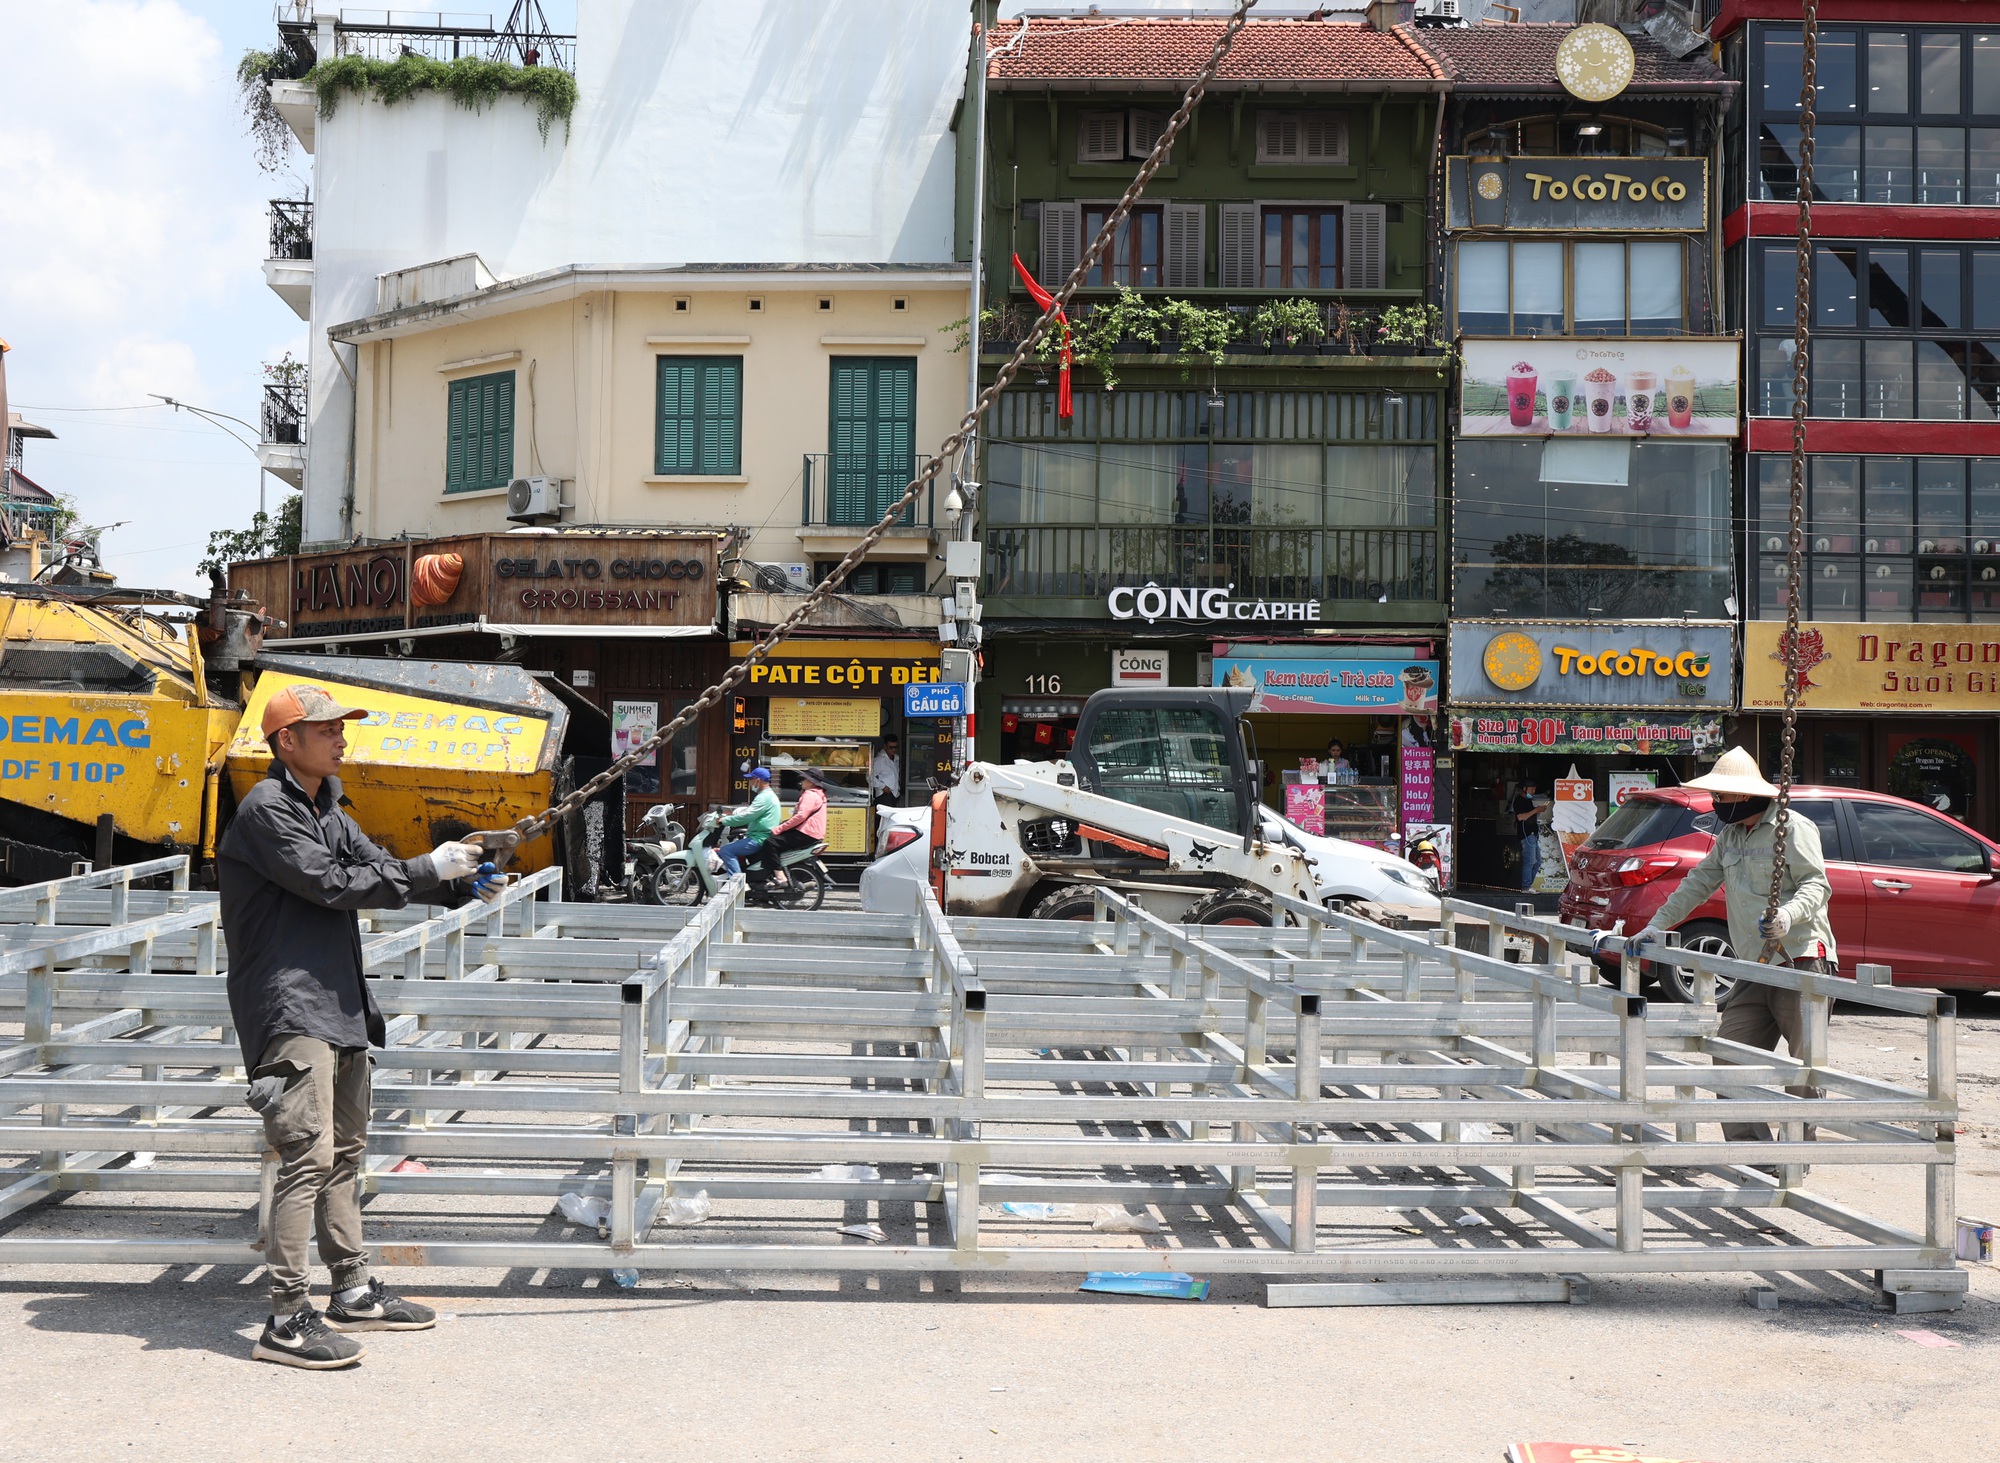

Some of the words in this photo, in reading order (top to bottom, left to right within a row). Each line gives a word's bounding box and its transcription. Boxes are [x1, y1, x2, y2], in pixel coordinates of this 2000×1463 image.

[496, 558, 601, 579] GELATO
[610, 558, 705, 580] CHOCO
[520, 588, 680, 611] CROISSANT
[1108, 581, 1230, 625] CỘNG
[1858, 633, 2000, 669] Dragon
[1119, 657, 1162, 672] CỘNG
[751, 665, 820, 684] PATE
[826, 658, 883, 690] CỘT
[1265, 669, 1297, 687] Kem
[1298, 669, 1330, 687] tươi
[1340, 667, 1365, 687] Trà
[1366, 668, 1394, 687] sữa
[1883, 670, 1954, 693] Suoi
[931, 685, 950, 695] PHỐ
[1025, 674, 1061, 694] 116
[1678, 681, 1707, 696] Tea
[911, 696, 938, 712] CẦU
[941, 694, 960, 711] GỖ
[1355, 694, 1370, 702] Milk
[1876, 701, 1933, 709] dragontea.com.vn
[618, 705, 652, 715] SUMMER
[0, 715, 151, 749] EMAG
[1478, 719, 1504, 733] Size
[1506, 719, 1519, 733] M
[1571, 726, 1604, 742] Tặng
[1605, 726, 1633, 740] Kem
[1636, 723, 1670, 740] Miễn
[1671, 725, 1692, 741] Phí
[380, 736, 418, 751] DF
[427, 740, 503, 756] 110P
[1499, 734, 1518, 745] giá
[735, 746, 756, 758] CỘT
[1403, 749, 1431, 757] Minsu
[1905, 748, 1923, 758] SOFT
[1924, 748, 1958, 761] OPENING
[2, 759, 40, 780] DF
[48, 761, 125, 783] 110P
[937, 760, 952, 771] SẢ
[734, 778, 748, 790] ĐÈ
[1404, 773, 1430, 784] HoLo
[1406, 790, 1428, 800] HoLo
[1573, 782, 1592, 800] 8K
[1403, 802, 1432, 812] Candy
[970, 852, 1010, 865] Bobcat
